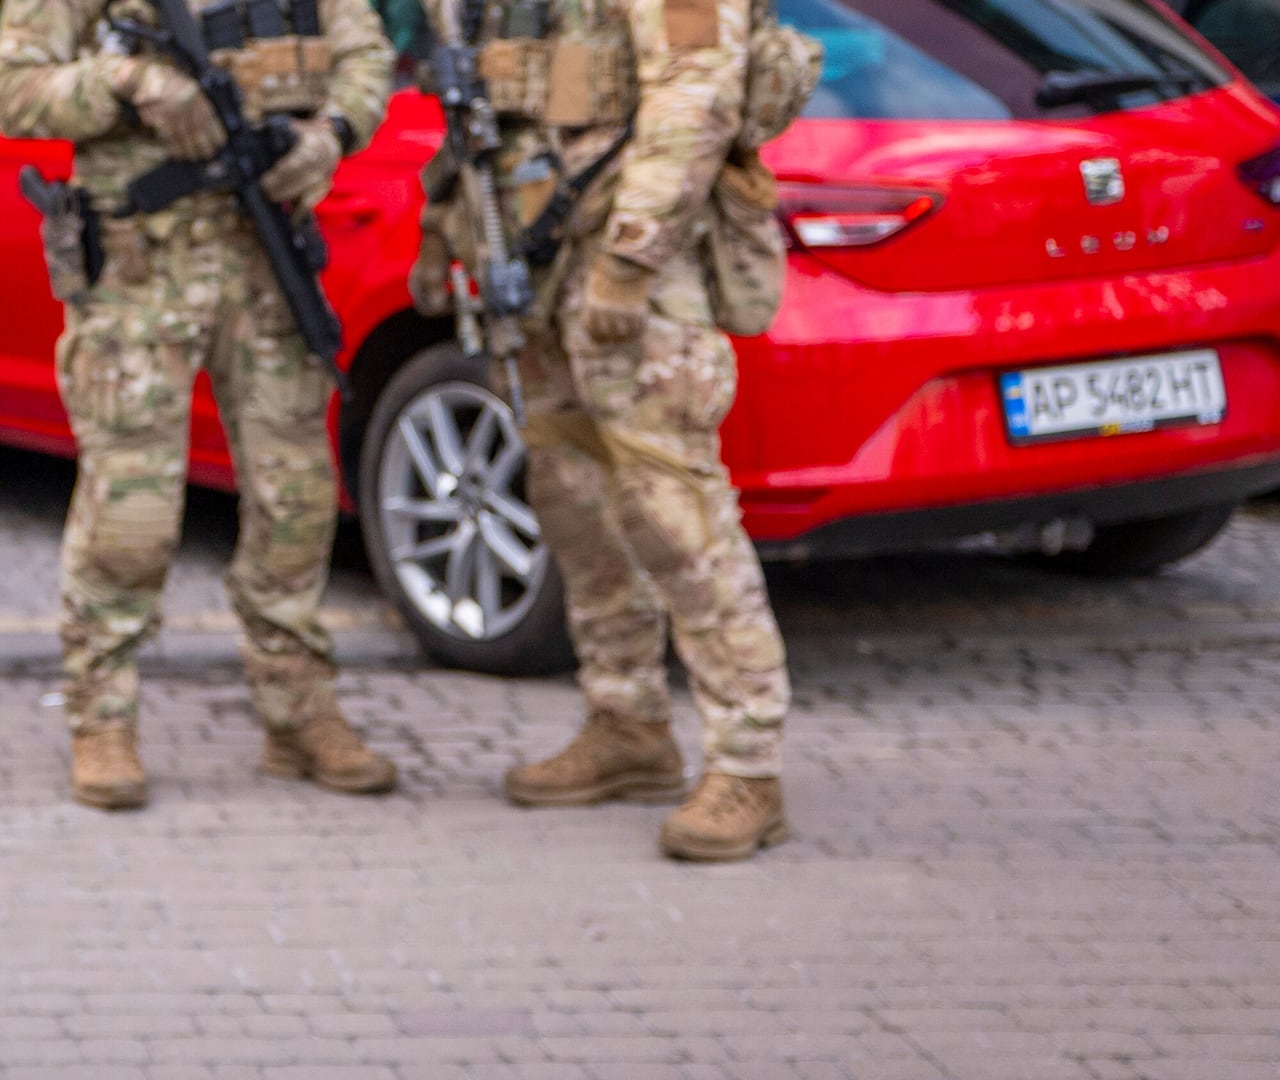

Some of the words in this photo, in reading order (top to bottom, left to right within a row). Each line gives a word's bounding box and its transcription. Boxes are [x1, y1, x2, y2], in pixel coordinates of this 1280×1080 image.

[1031, 375, 1078, 423] AP
[1087, 366, 1166, 417] 5482
[1168, 361, 1211, 407] HT
